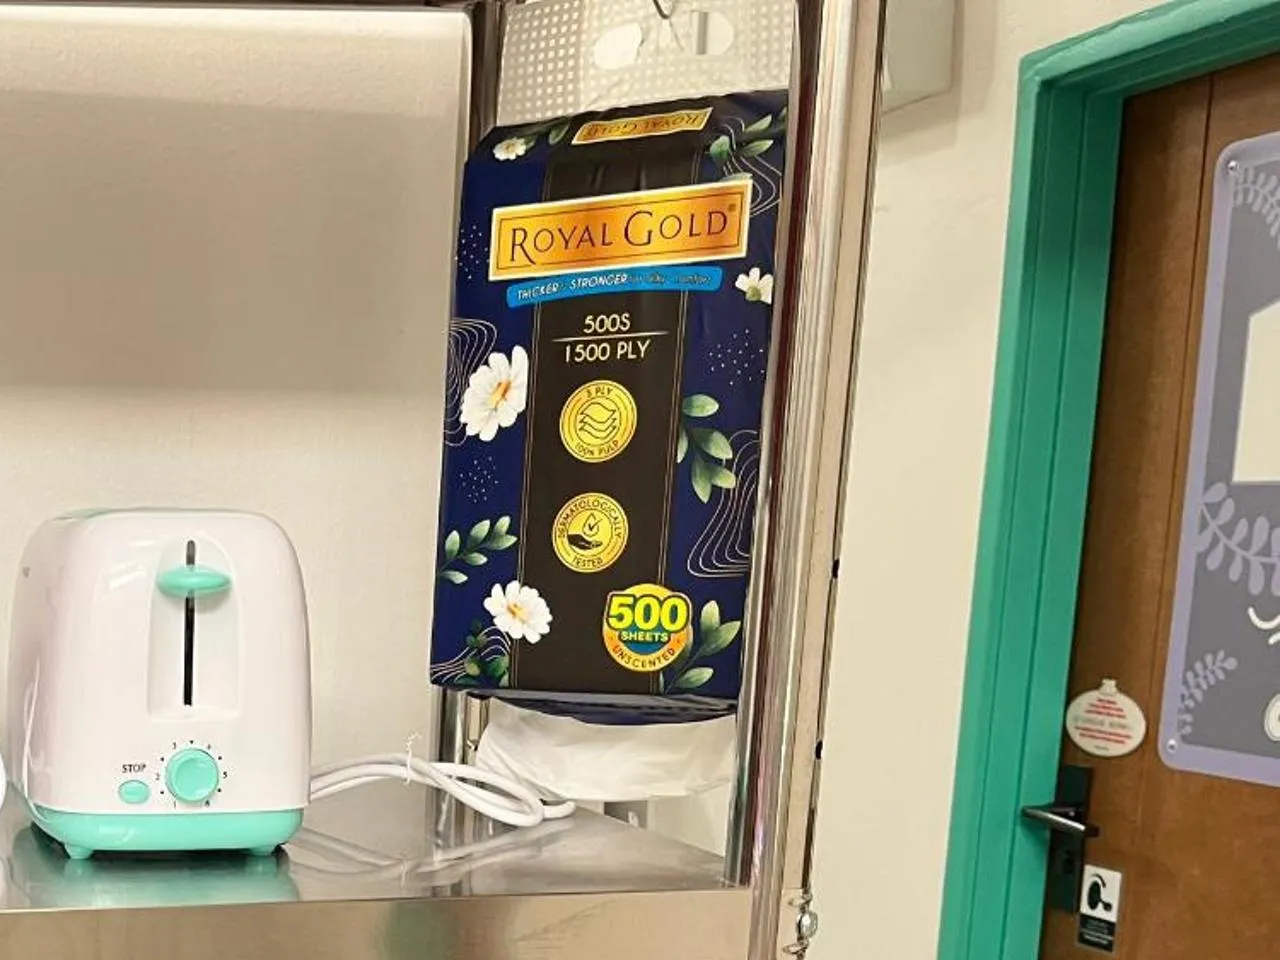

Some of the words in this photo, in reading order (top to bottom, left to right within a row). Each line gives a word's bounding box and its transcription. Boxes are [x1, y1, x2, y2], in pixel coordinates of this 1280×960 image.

[509, 221, 614, 266] ROYAL
[623, 209, 728, 247] GOLD
[569, 273, 628, 291] STRONGER
[583, 312, 632, 334] 500S
[565, 342, 610, 363] 1500
[616, 339, 651, 360] PLY
[595, 386, 613, 395] PLY
[598, 439, 619, 456] PULP
[572, 555, 604, 568] TESTED
[607, 595, 689, 632] 500
[620, 630, 669, 643] SHEETS
[612, 644, 676, 668] UNSCENTED
[122, 763, 147, 774] STOP
